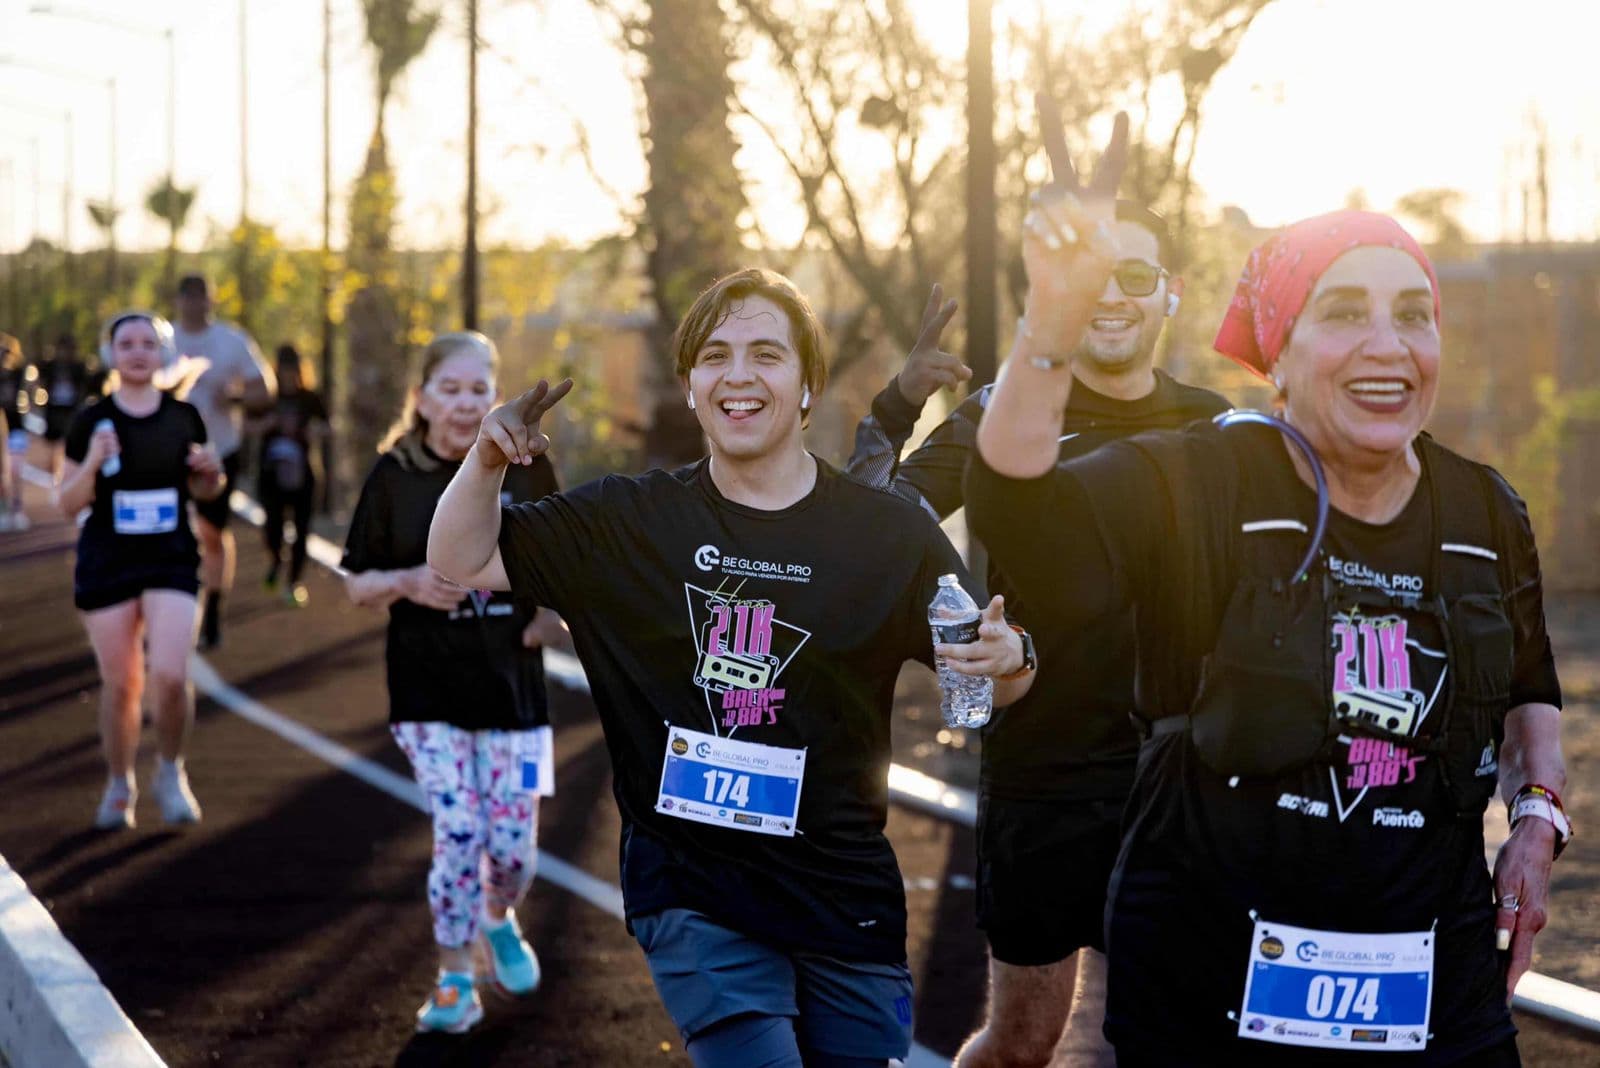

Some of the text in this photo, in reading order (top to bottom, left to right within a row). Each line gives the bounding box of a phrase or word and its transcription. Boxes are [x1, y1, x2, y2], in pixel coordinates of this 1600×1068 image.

[722, 556, 812, 577] BE GLOBAL PRO
[1392, 574, 1424, 591] PRO
[708, 604, 776, 656] 21K
[1333, 620, 1412, 693] 21K
[722, 688, 770, 709] BACK
[722, 752, 751, 763] GLOBAL
[752, 757, 769, 766] PRO
[703, 769, 751, 809] 174
[1373, 808, 1426, 829] Puente
[1321, 949, 1333, 960] BE
[1334, 950, 1373, 961] GLOBAL
[1375, 951, 1396, 962] PRO
[1306, 974, 1380, 1022] 074
